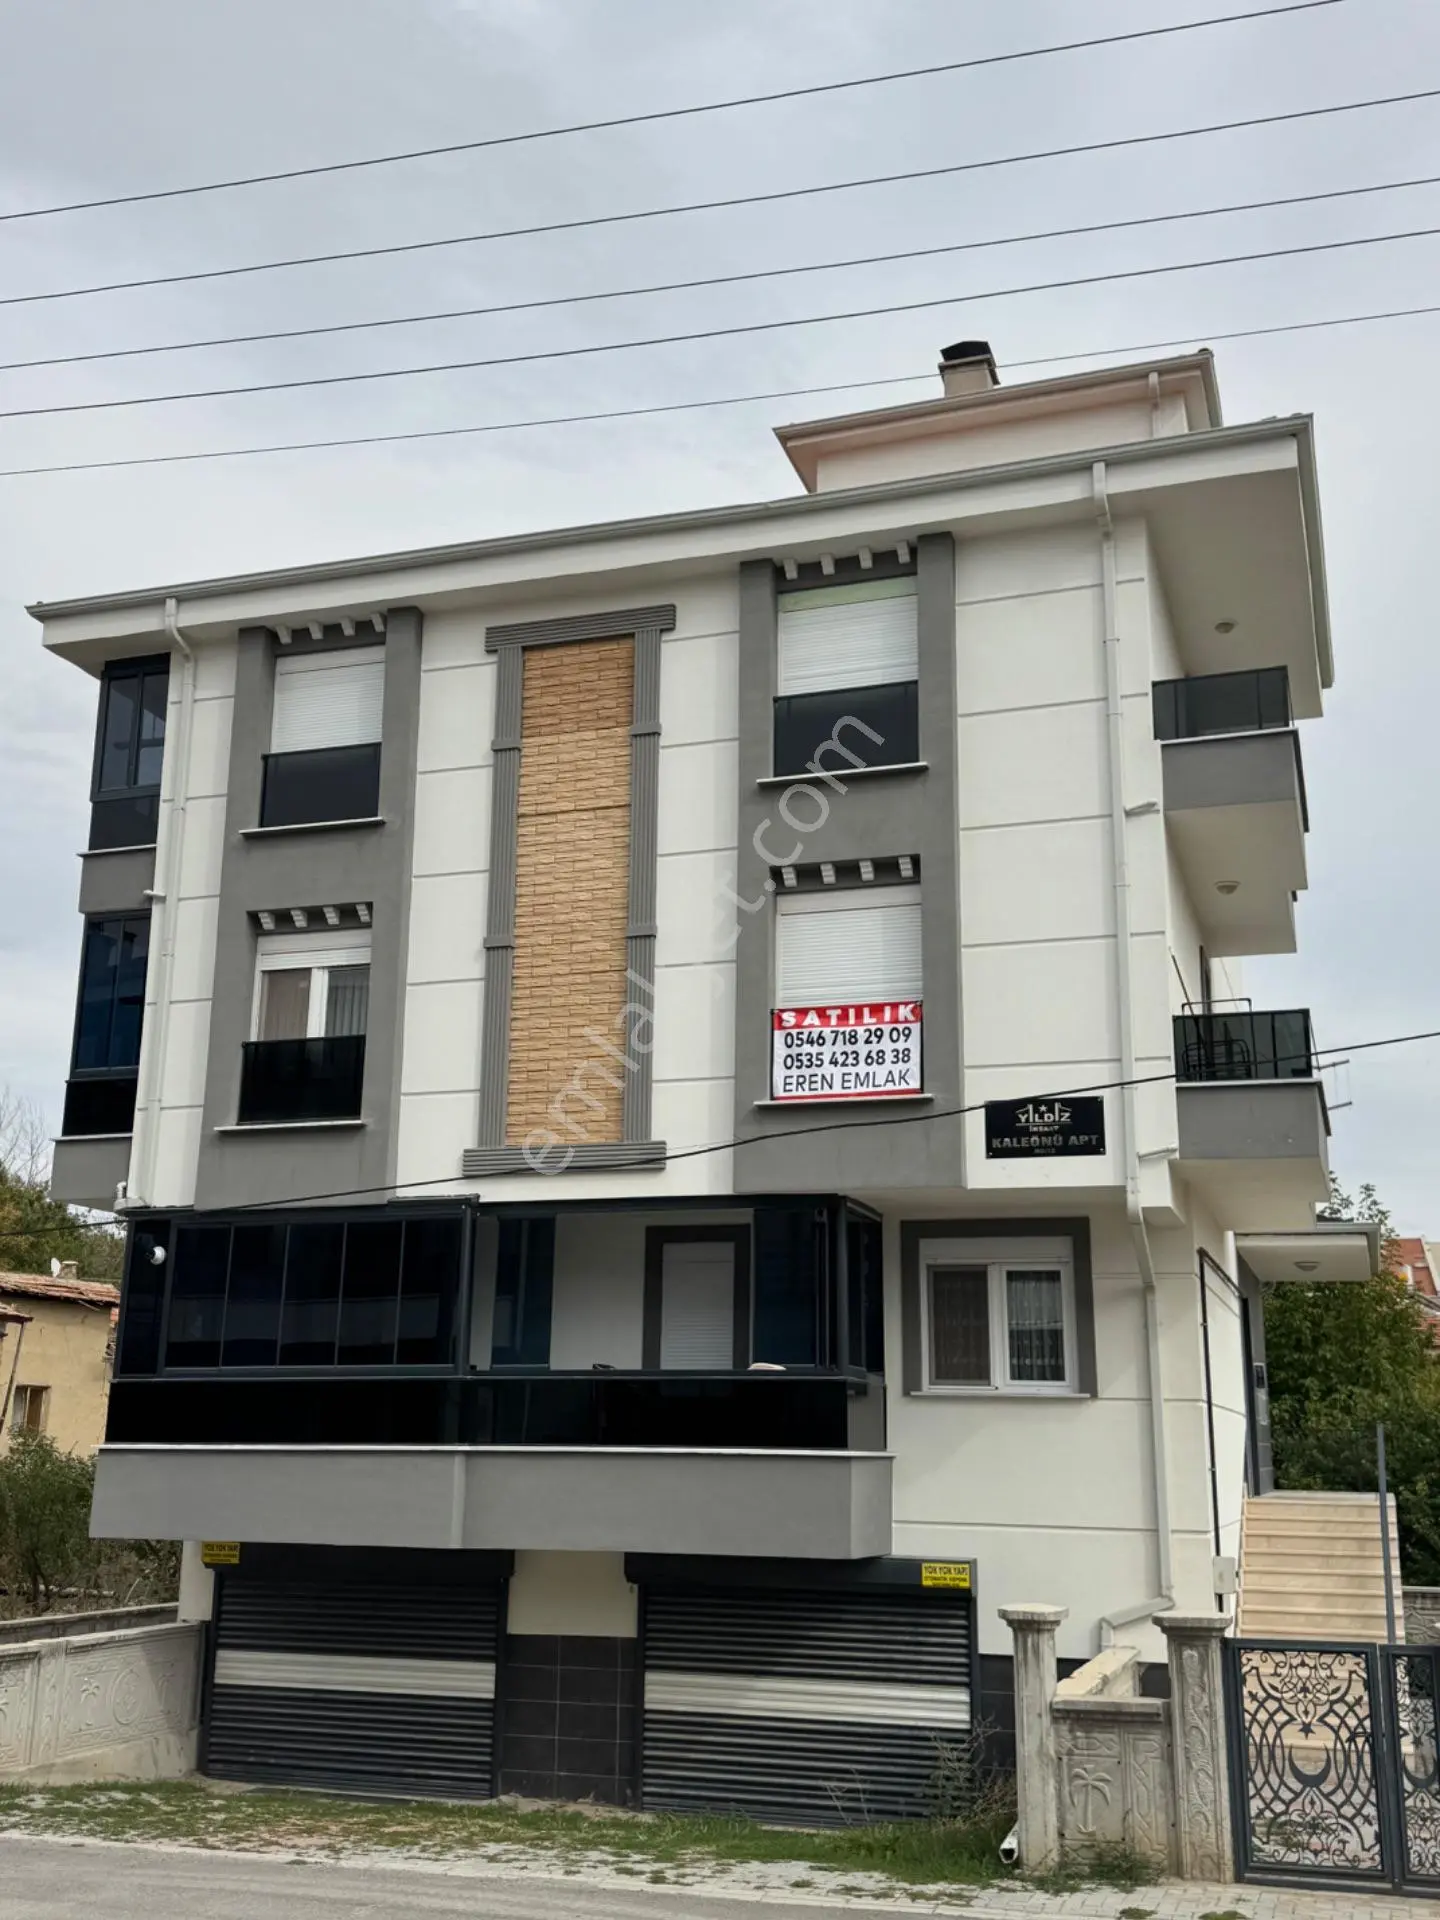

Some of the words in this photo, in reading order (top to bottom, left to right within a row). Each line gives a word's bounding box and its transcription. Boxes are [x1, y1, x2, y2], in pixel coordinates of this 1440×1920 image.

[781, 1003, 915, 1027] SATILIK
[784, 1030, 826, 1048] 0546
[830, 1029, 858, 1046] 718
[863, 1027, 884, 1045] 29
[889, 1026, 912, 1044] 09
[783, 1052, 824, 1070] 0535
[828, 1050, 860, 1068] 423
[864, 1049, 886, 1066] 68
[890, 1048, 911, 1064] 38
[783, 1073, 834, 1093] EREN
[841, 1068, 910, 1090] EMLAK
[1017, 1102, 1071, 1123] YILDIZ
[1068, 1134, 1100, 1146] APT
